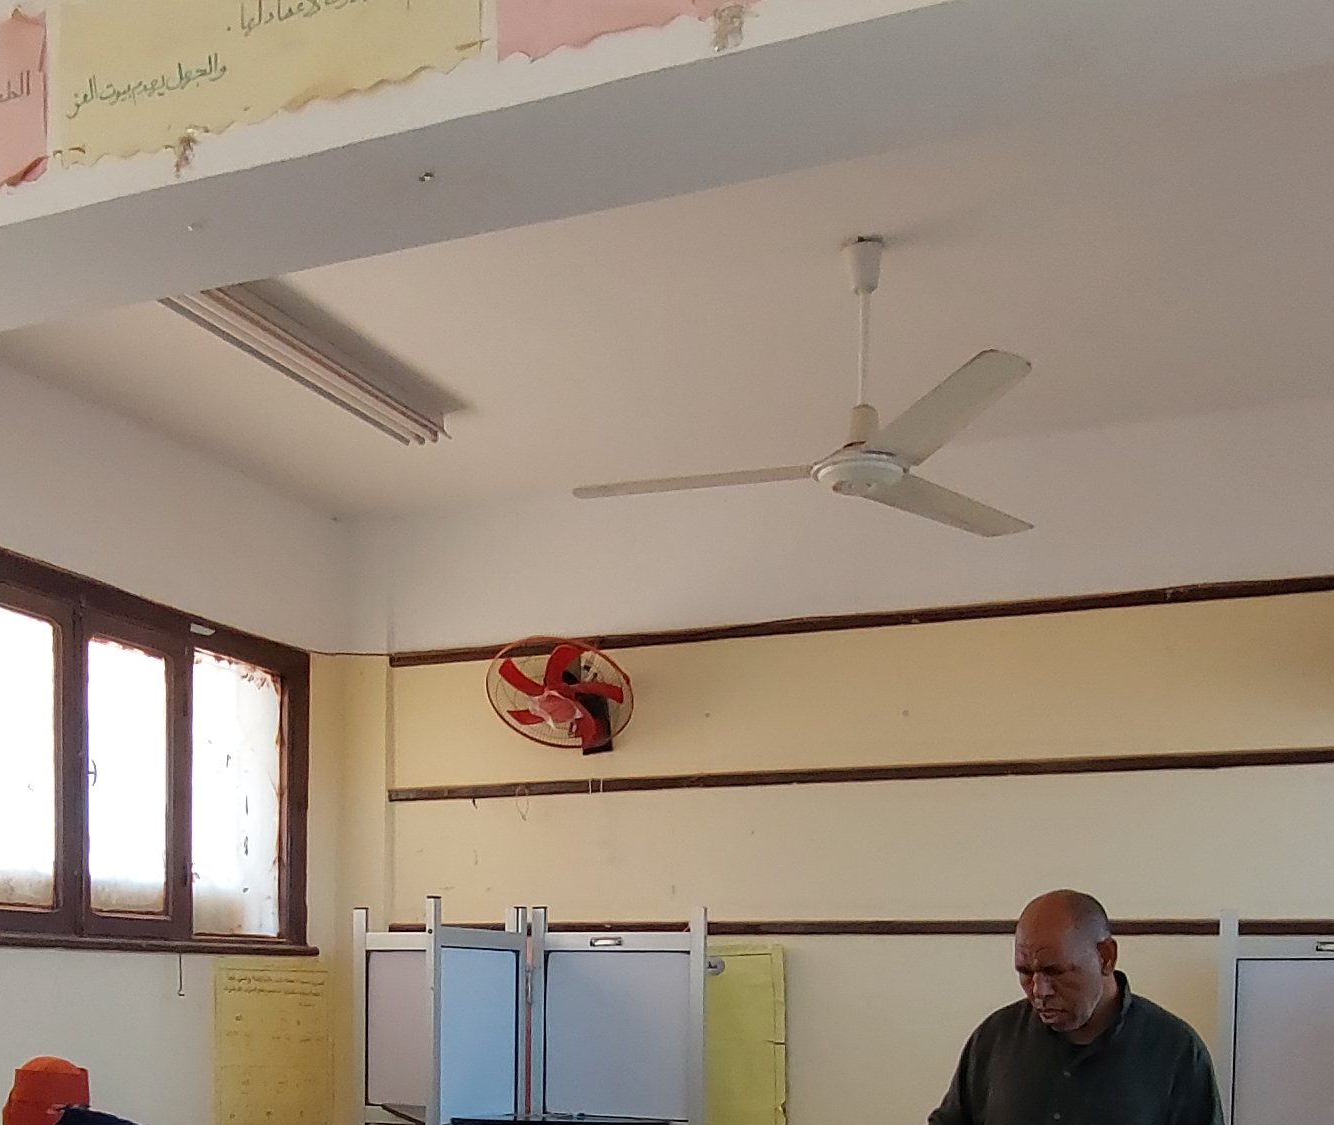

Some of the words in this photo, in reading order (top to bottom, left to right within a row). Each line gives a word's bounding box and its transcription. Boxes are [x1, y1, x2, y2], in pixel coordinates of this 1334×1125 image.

[167, 53, 227, 91] والجهل
[99, 83, 132, 106] بيوت
[133, 74, 166, 105] يهدم
